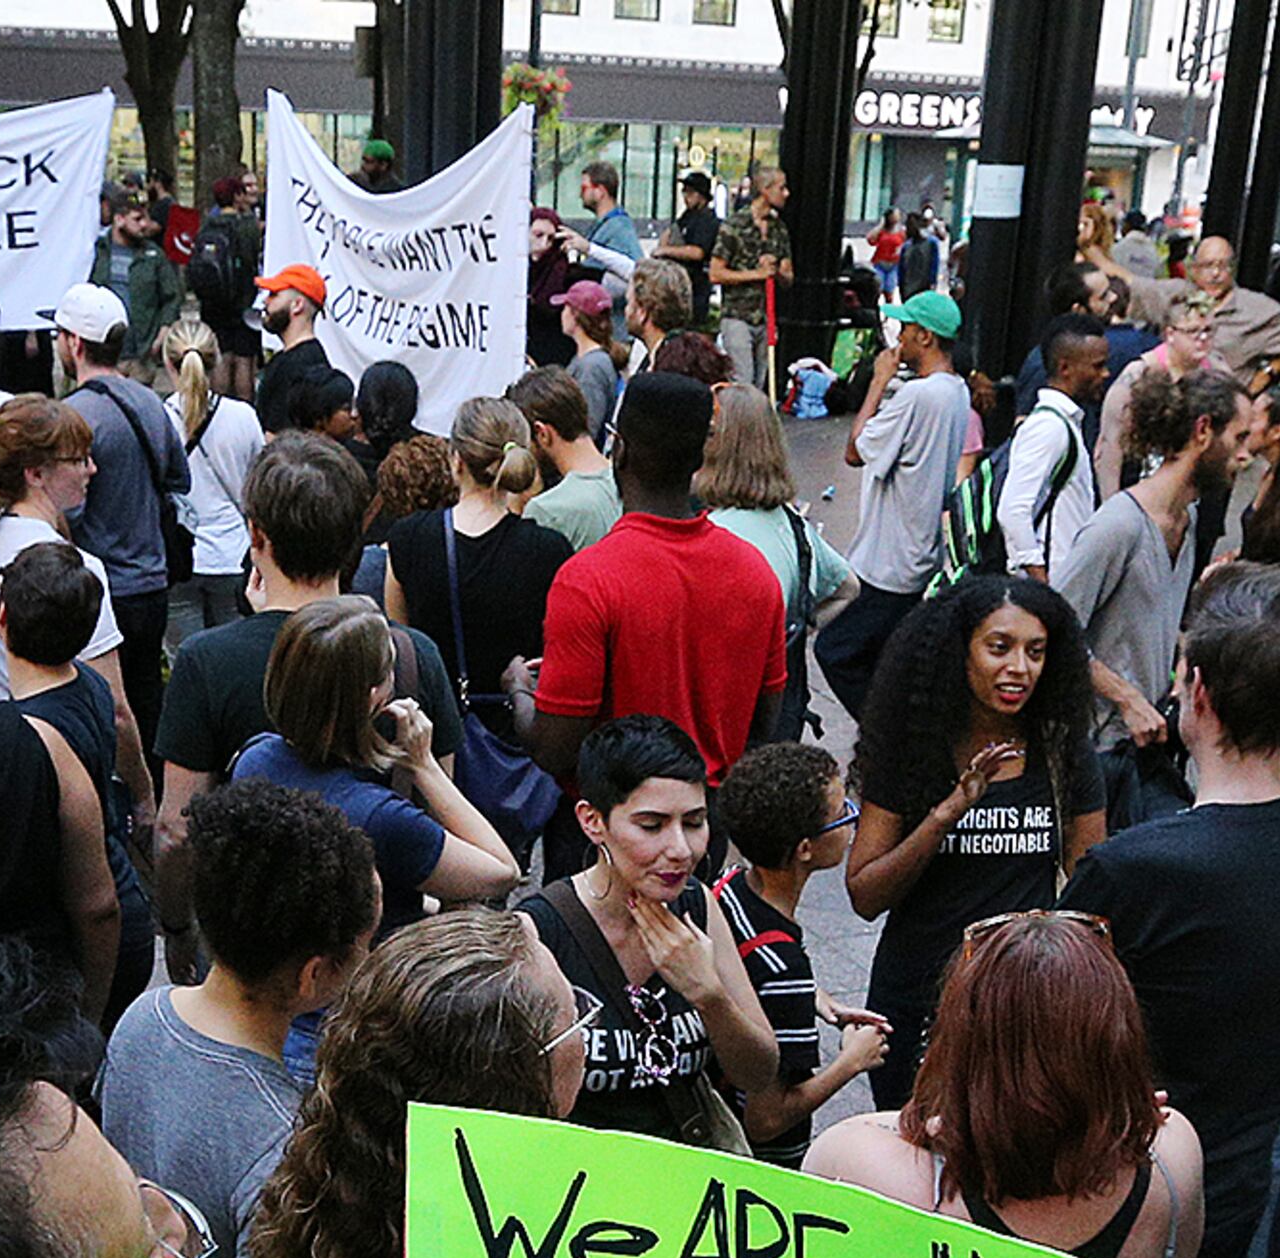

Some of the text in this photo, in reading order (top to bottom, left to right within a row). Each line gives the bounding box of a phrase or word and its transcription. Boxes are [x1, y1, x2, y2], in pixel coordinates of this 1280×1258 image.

[382, 228, 452, 272] WANT
[332, 285, 368, 327] OF
[1023, 806, 1053, 828] ARE
[960, 831, 1050, 854] NEGOTIABLE
[585, 1068, 625, 1092] OT
